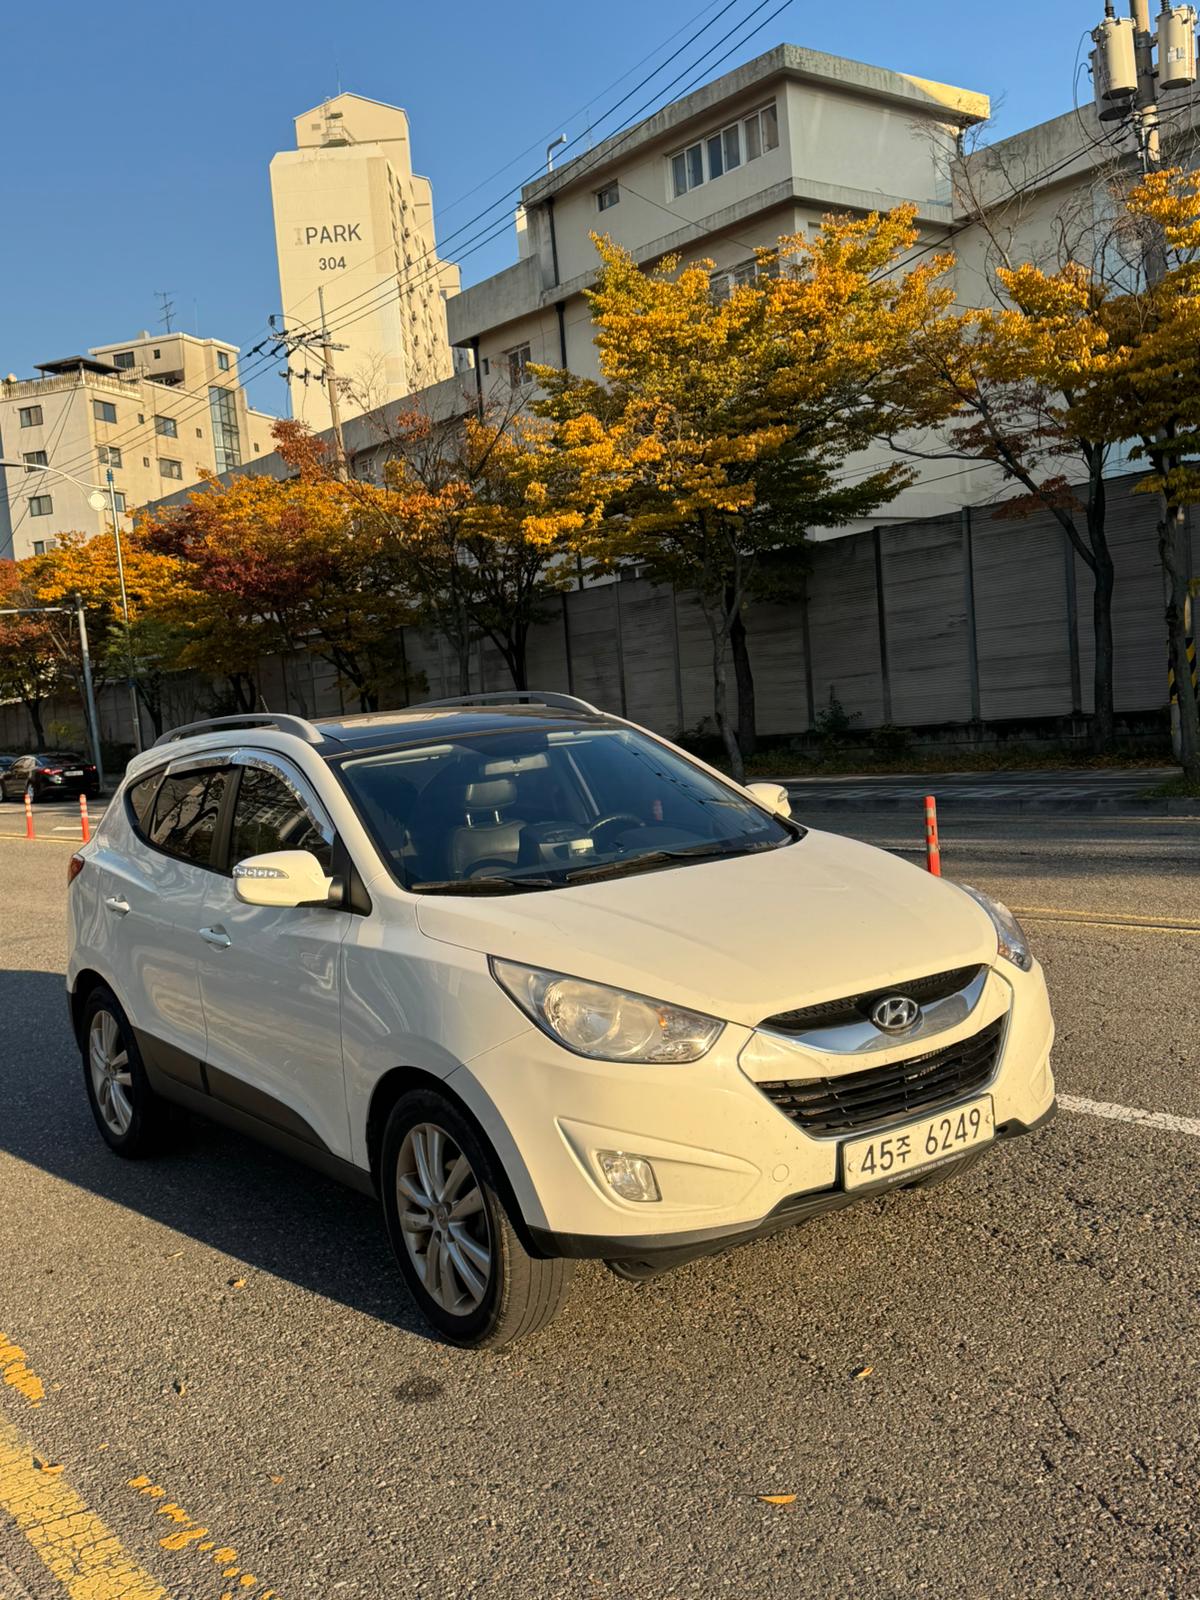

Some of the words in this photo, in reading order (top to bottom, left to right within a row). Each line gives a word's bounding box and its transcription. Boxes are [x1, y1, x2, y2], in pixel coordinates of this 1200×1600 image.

[319, 256, 346, 271] 304
[860, 1135, 911, 1175] 45주
[925, 1108, 981, 1155] 6249
